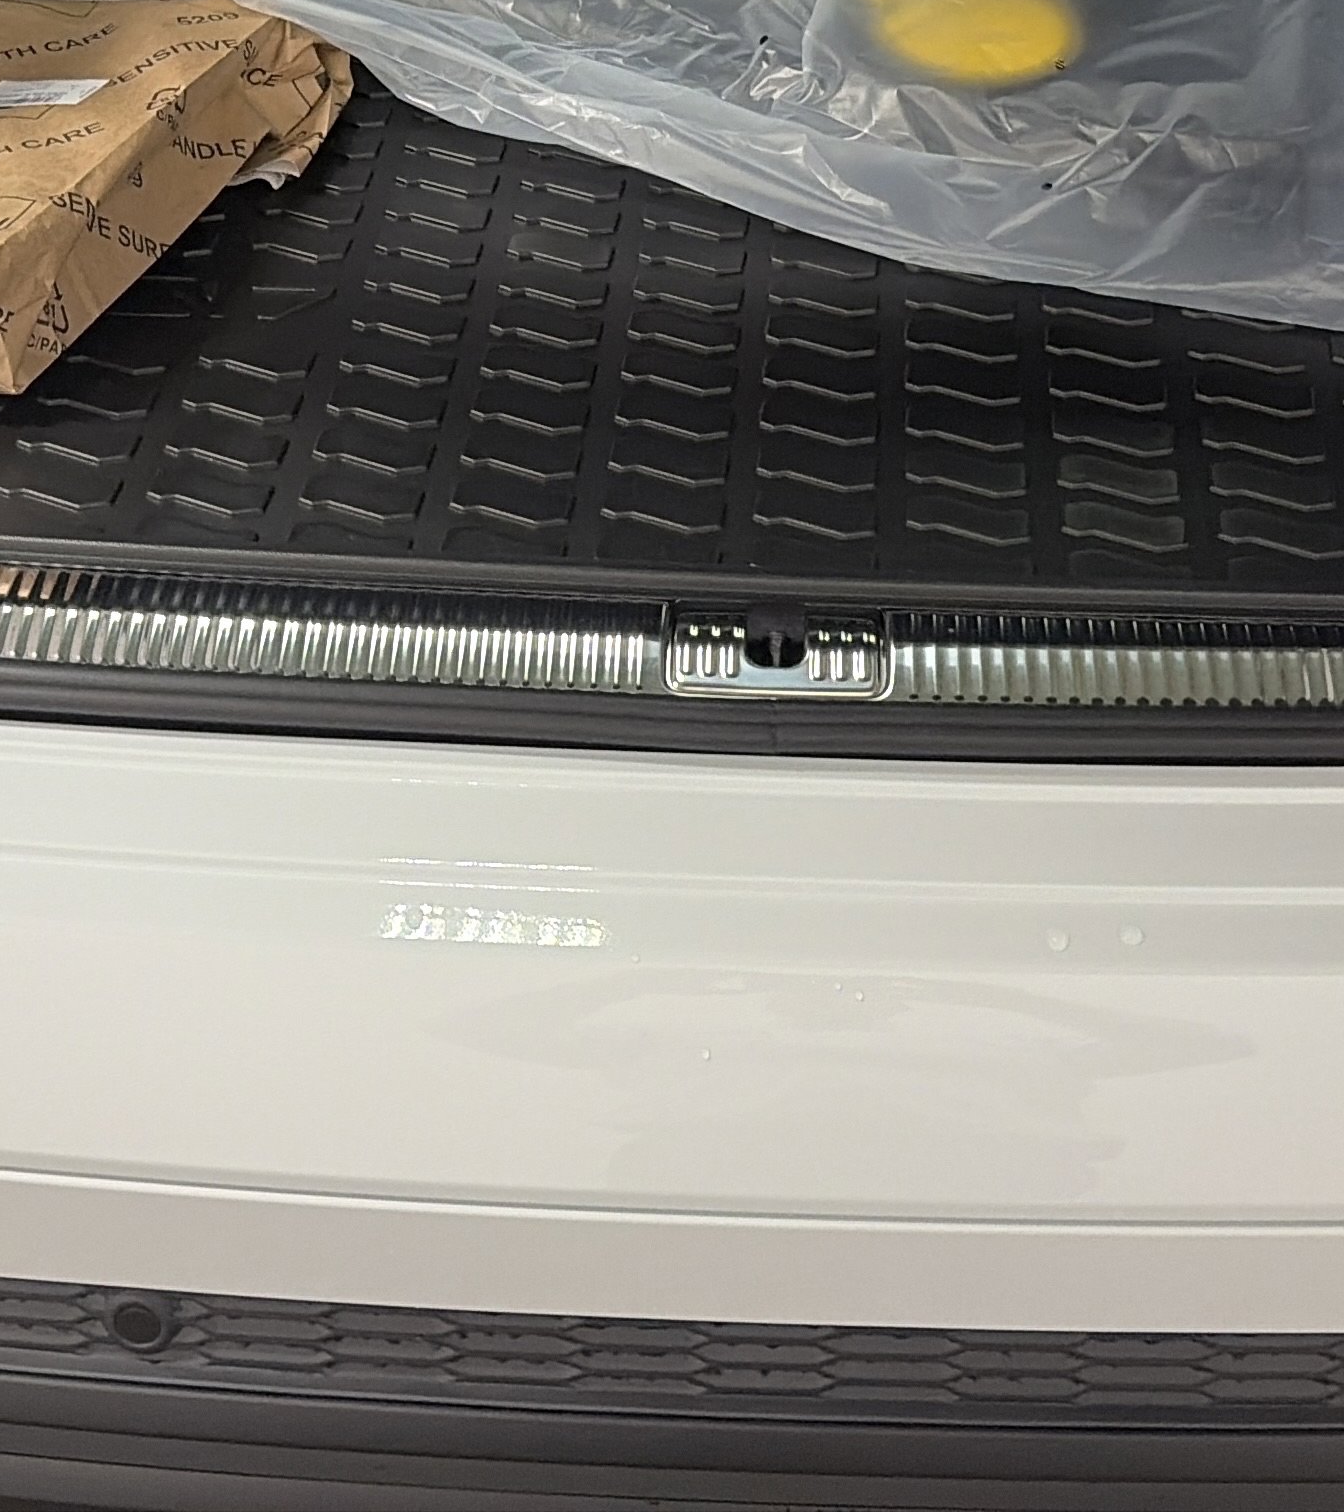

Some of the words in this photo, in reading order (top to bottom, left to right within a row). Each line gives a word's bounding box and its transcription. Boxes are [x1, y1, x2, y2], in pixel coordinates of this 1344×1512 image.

[176, 12, 240, 26] 5209
[44, 22, 120, 53] CARE
[20, 120, 105, 150] CARE
